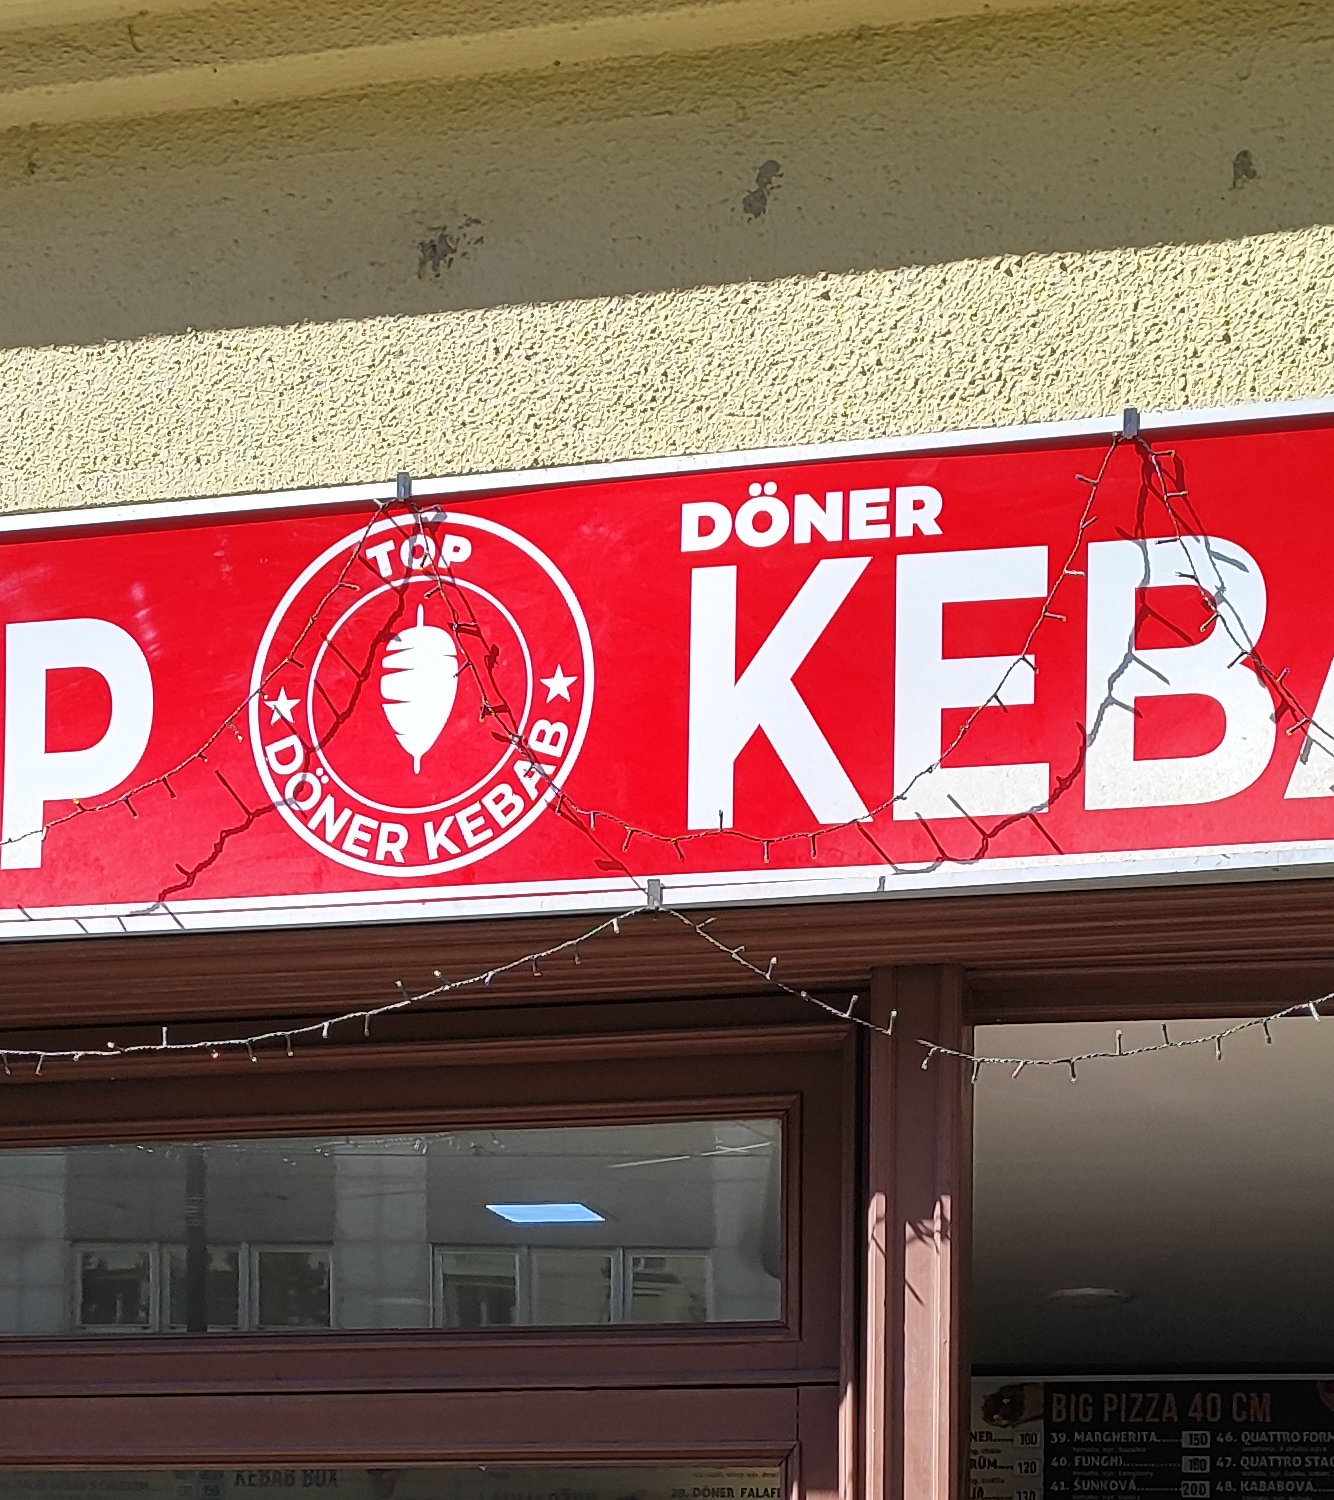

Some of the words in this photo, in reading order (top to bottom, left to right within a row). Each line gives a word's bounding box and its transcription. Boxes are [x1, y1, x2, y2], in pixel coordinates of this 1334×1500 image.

[679, 484, 942, 554] DÖNER
[364, 534, 474, 578] TOP
[265, 733, 411, 864] DÖNER
[422, 718, 571, 859] KEBAB
[1052, 1393, 1093, 1422] BIG
[1103, 1393, 1178, 1423] PIZZA
[1188, 1393, 1222, 1423] 40
[1232, 1392, 1271, 1423] CM
[1074, 1432, 1157, 1443] MARGHERITA
[1188, 1434, 1207, 1445] 150
[1241, 1432, 1300, 1444] QUATTRO
[1074, 1456, 1122, 1467] FUNGHI
[1240, 1457, 1301, 1469] QUATTRO
[1073, 1477, 1136, 1491] ŠUNKOVÁ
[1183, 1483, 1206, 1495] 200
[1240, 1478, 1314, 1491] KABABOVÁ
